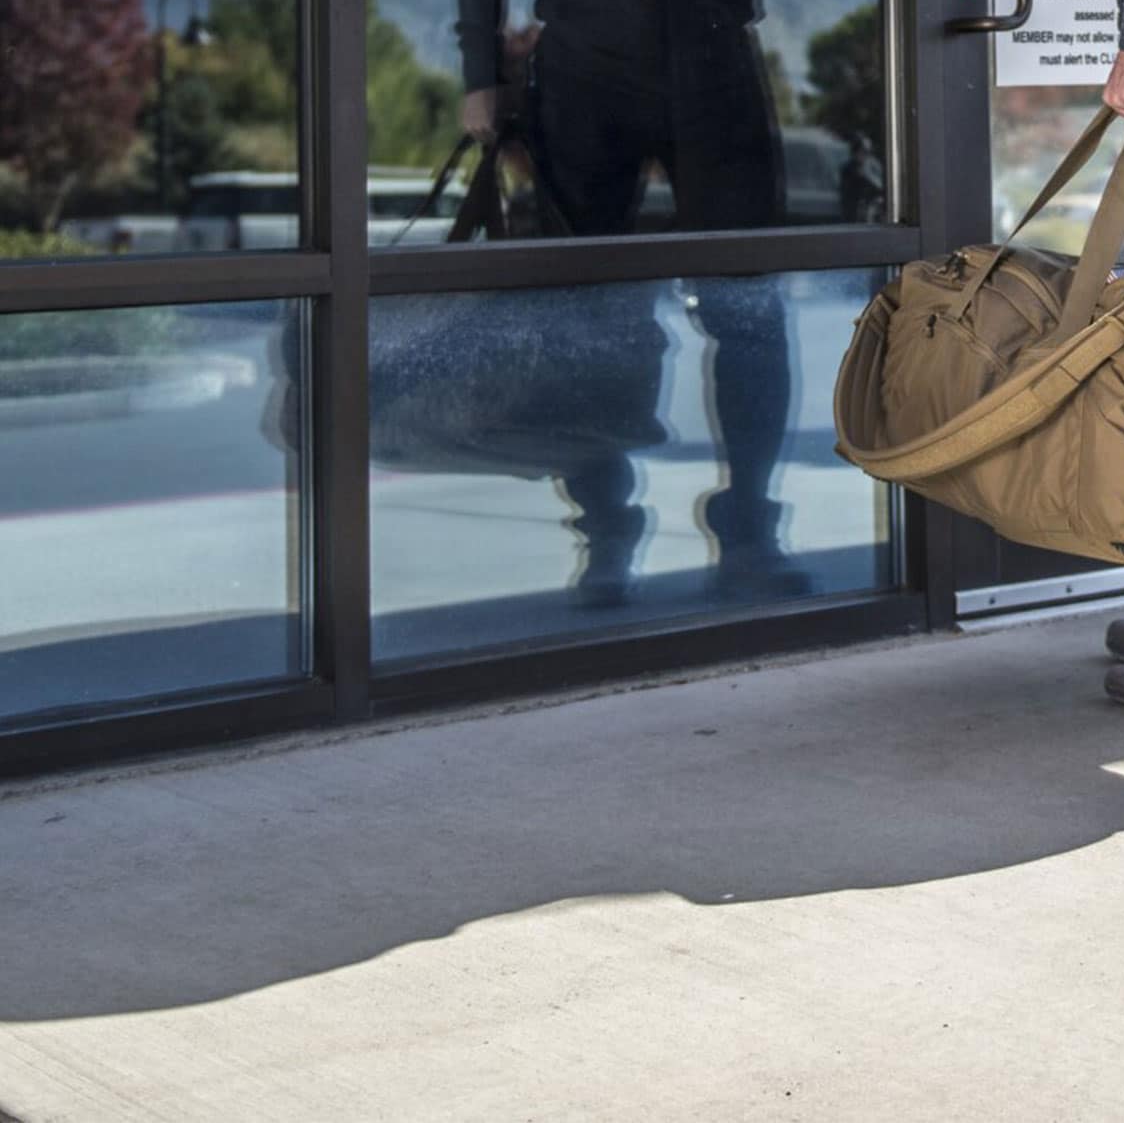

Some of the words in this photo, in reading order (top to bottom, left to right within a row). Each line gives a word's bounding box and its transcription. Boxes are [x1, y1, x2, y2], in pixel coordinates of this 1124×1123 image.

[1074, 10, 1114, 21] assessed
[1012, 31, 1054, 43] MEMBER
[1056, 33, 1074, 45] may
[1076, 33, 1091, 43] not
[1092, 32, 1114, 43] allow
[1040, 54, 1062, 65] must
[1064, 53, 1083, 65] alert
[1085, 54, 1098, 65] the
